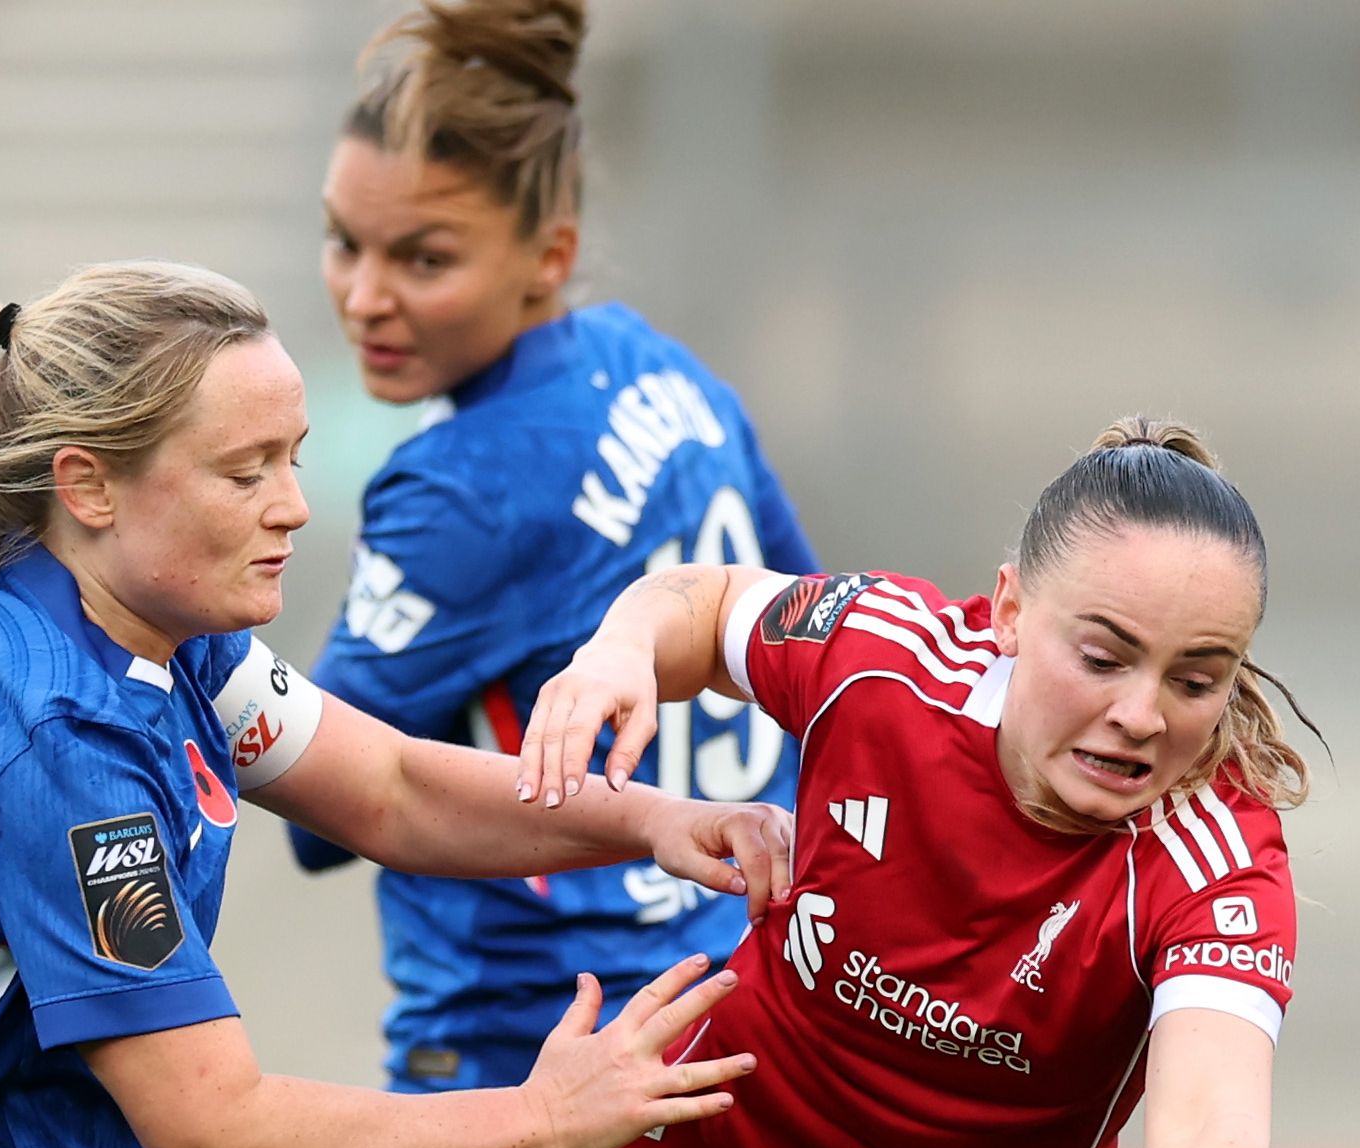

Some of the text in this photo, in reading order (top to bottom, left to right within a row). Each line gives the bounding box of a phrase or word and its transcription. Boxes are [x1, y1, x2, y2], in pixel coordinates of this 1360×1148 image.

[808, 575, 861, 632] WSL
[86, 837, 161, 876] WSL
[108, 824, 153, 841] BARCLAYS
[834, 979, 1031, 1075] chartered
[843, 950, 1022, 1054] standard
